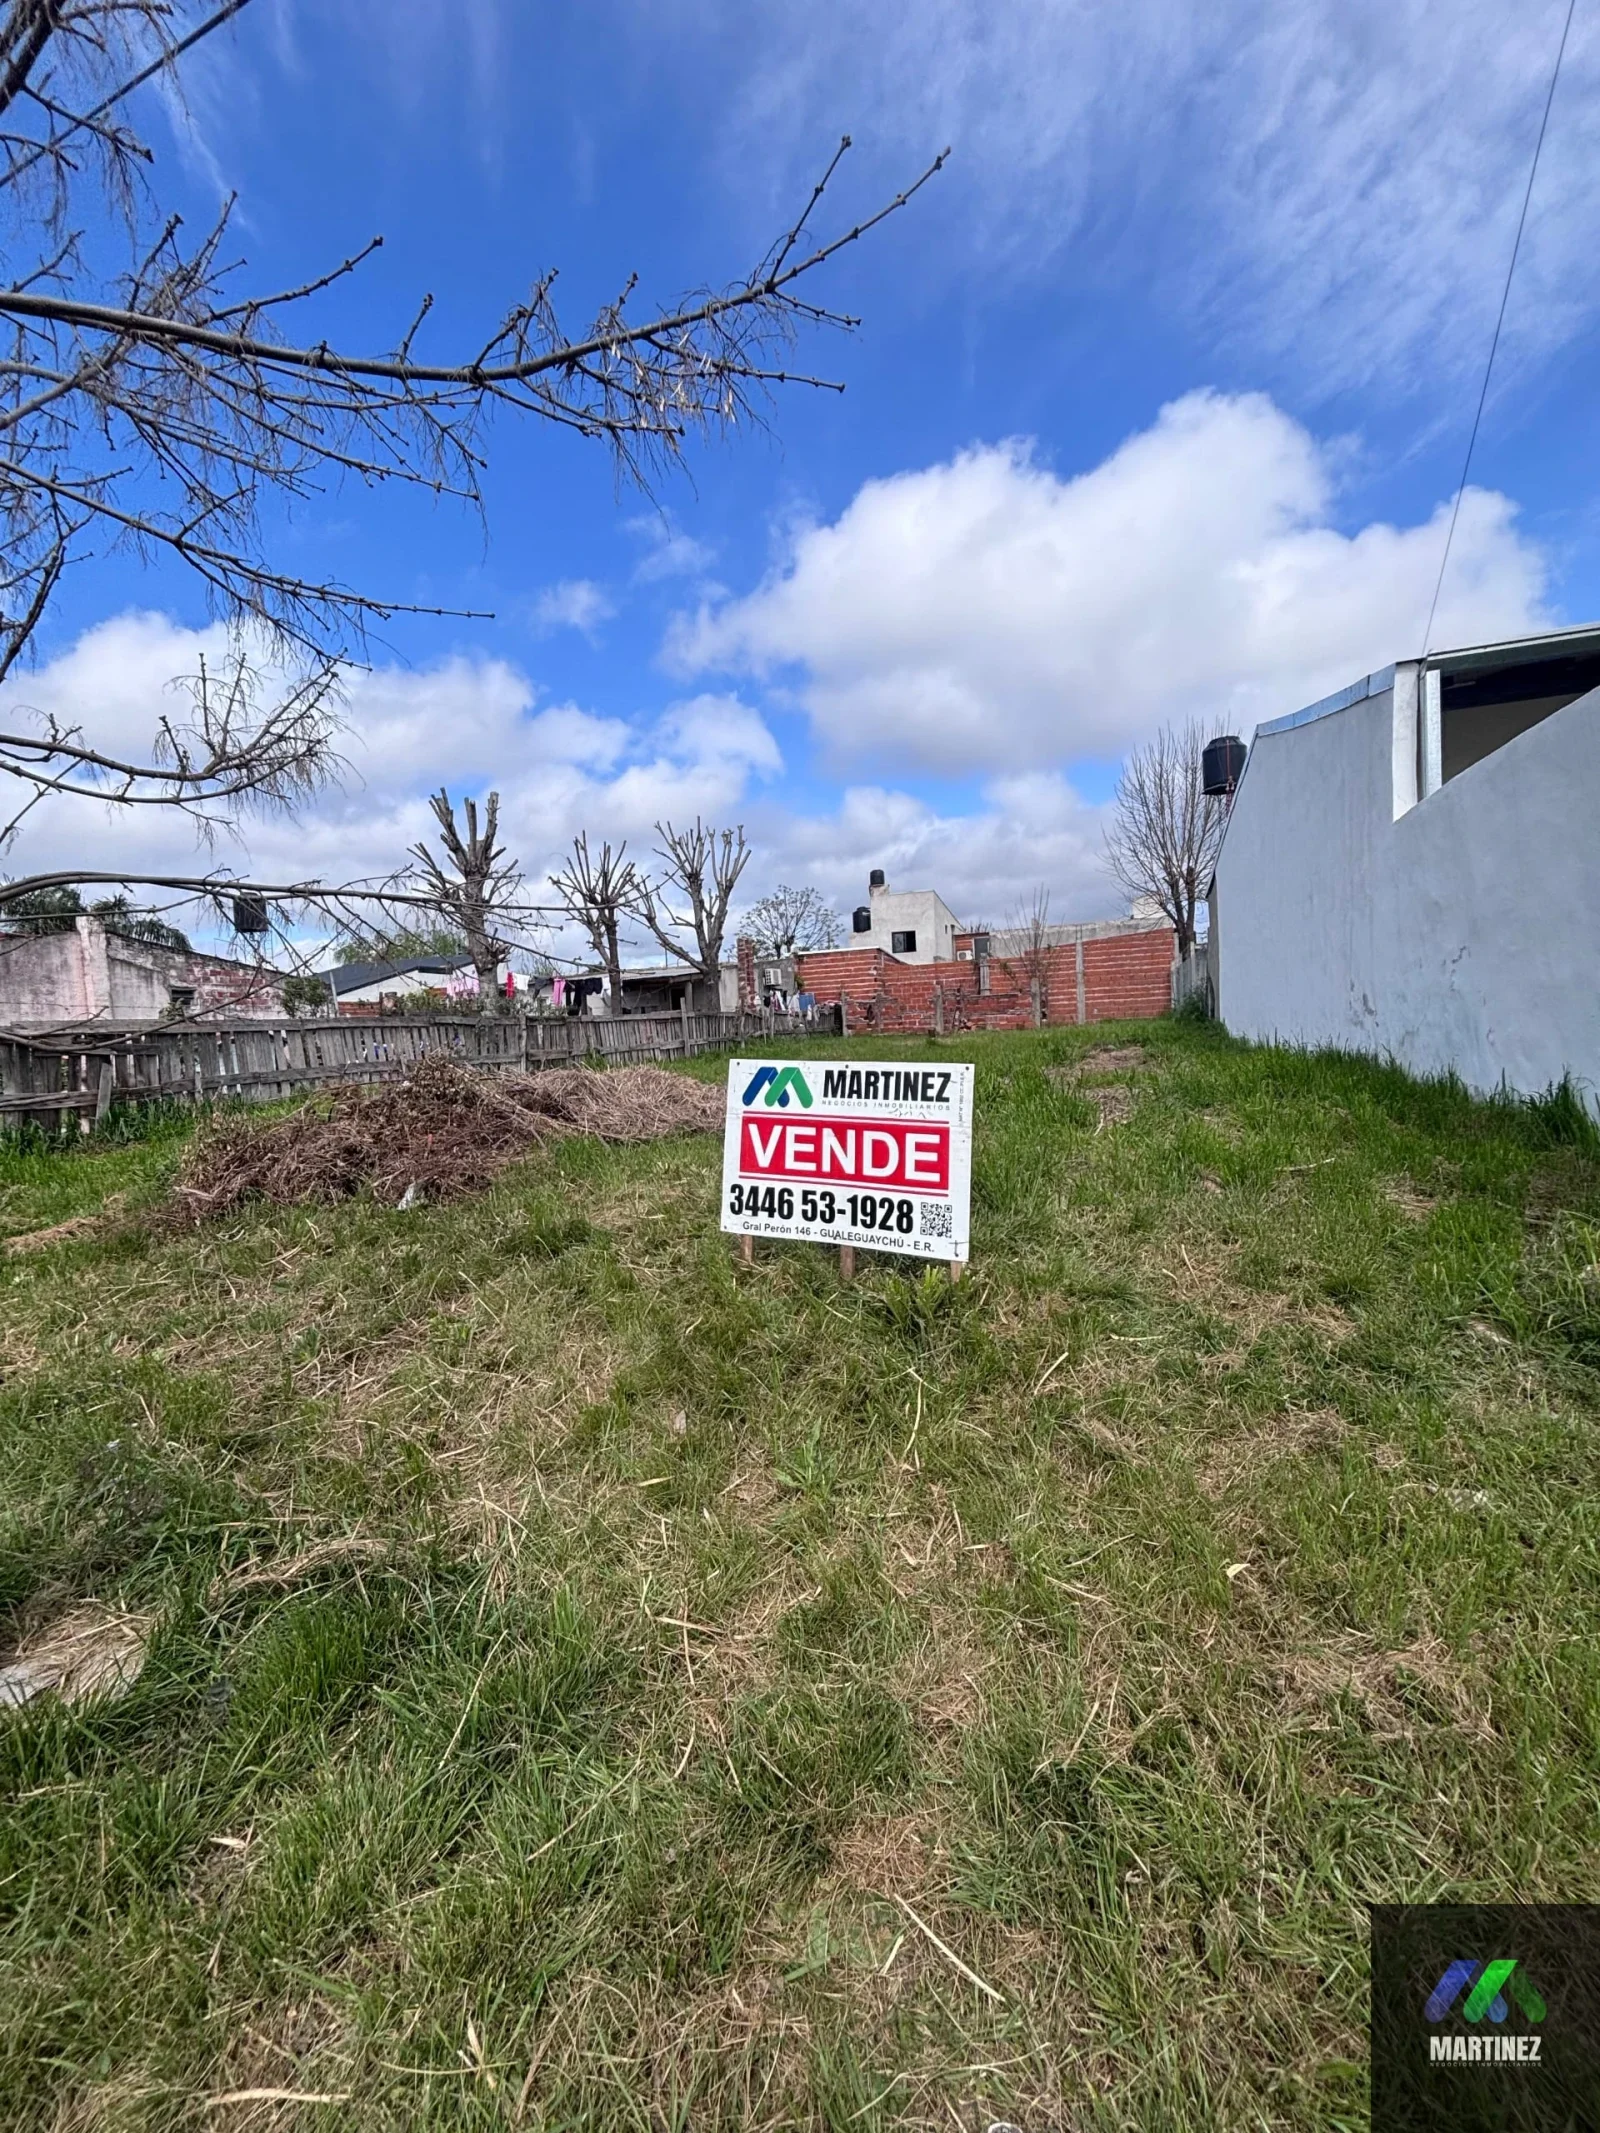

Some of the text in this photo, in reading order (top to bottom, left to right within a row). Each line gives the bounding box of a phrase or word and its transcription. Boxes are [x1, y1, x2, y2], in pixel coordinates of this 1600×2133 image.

[823, 1069, 952, 1103] MARTINEZ
[821, 1099, 951, 1111] NEGOCIOS INMOBILIARIOS
[748, 1123, 941, 1183] VENDE
[729, 1183, 914, 1234] 3446 53-1928
[742, 1221, 762, 1231] Gral
[764, 1223, 792, 1234] Perón
[795, 1226, 811, 1236] 146
[820, 1228, 904, 1248] GUALEGUAYCHÚ
[913, 1240, 935, 1253] E.R.
